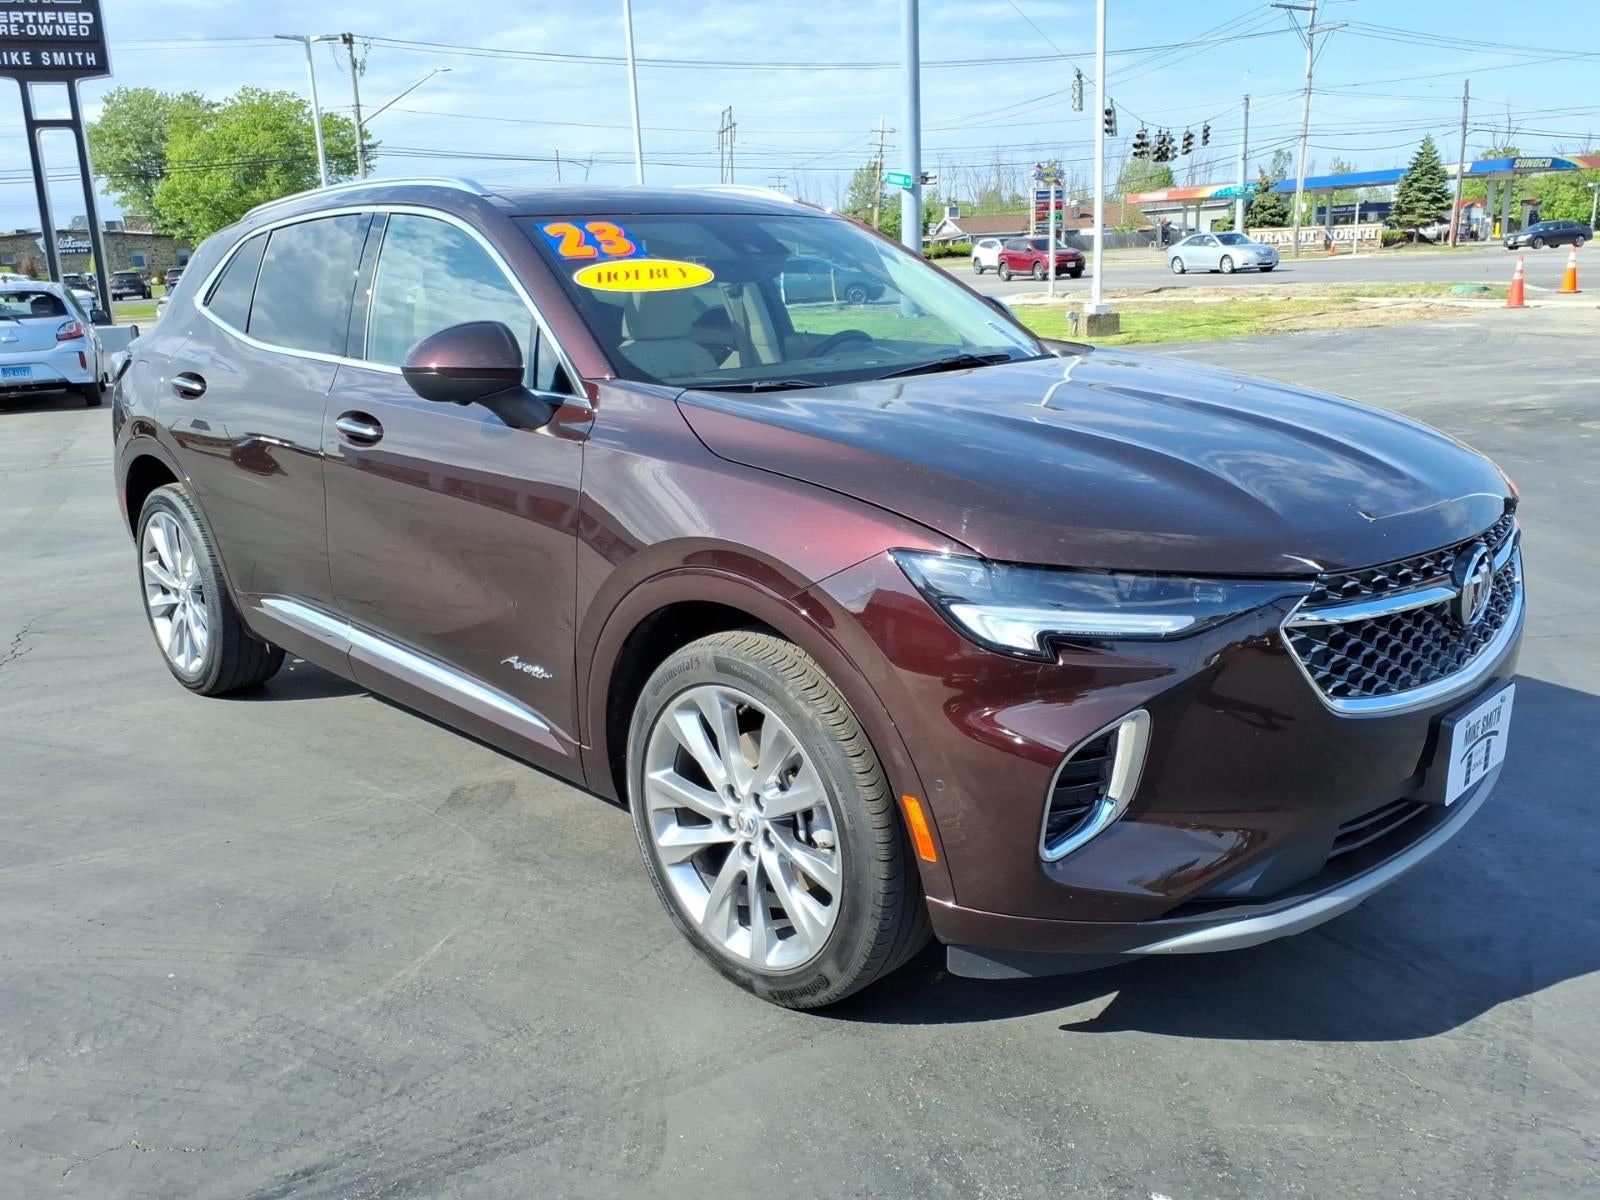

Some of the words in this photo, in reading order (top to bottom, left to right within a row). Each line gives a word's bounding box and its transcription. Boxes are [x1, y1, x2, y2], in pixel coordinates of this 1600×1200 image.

[0, 11, 94, 24] ERTIFIED
[0, 24, 90, 36] RE-OWNED
[0, 51, 32, 65] IKE
[41, 52, 96, 66] SMITH
[1513, 158, 1553, 168] SUNOCO
[543, 222, 636, 259] 23
[597, 270, 640, 283] HOT
[649, 268, 687, 280] BUY
[1464, 720, 1481, 747] MIKE
[1481, 705, 1502, 732] SMITH
